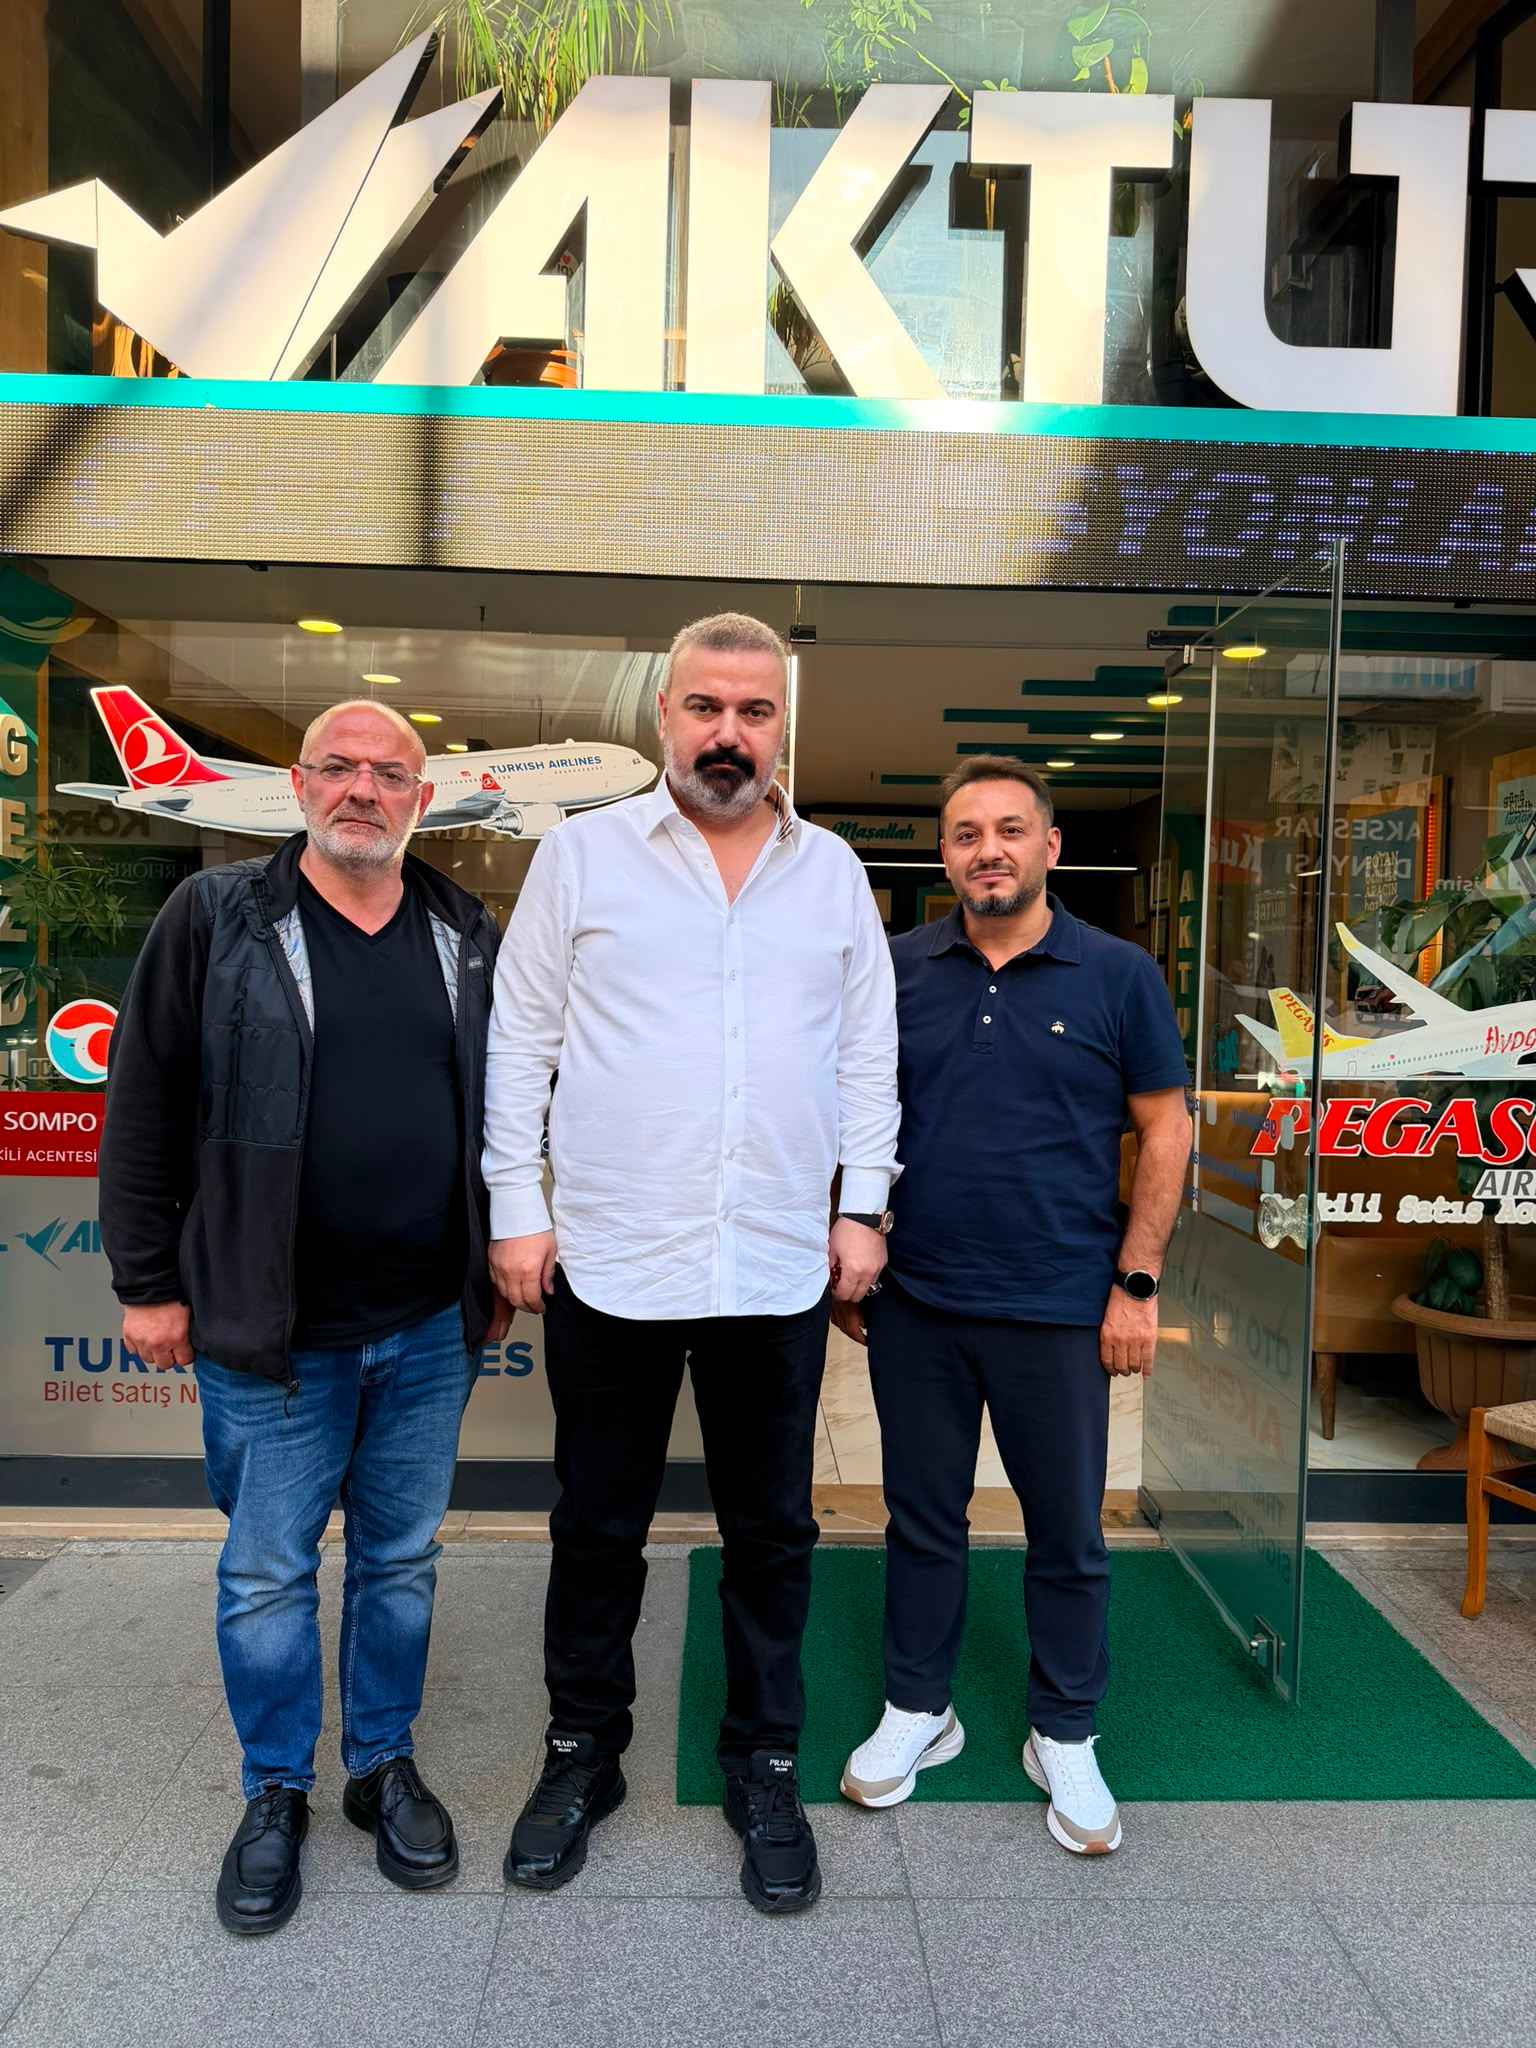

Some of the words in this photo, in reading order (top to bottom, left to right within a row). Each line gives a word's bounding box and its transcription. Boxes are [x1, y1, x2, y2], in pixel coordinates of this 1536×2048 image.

[488, 760, 545, 775] TURKISH
[549, 755, 602, 769] AIRLINES
[3, 1111, 97, 1132] SOMPO
[26, 1148, 97, 1163] ACENTESİ
[1476, 1170, 1536, 1196] AIR
[480, 1341, 534, 1377] ES
[44, 1381, 103, 1402] Bilet
[112, 1382, 171, 1408] Satış
[181, 1383, 198, 1404] N
[552, 1738, 578, 1748] PRADA
[769, 1759, 793, 1767] PRADA
